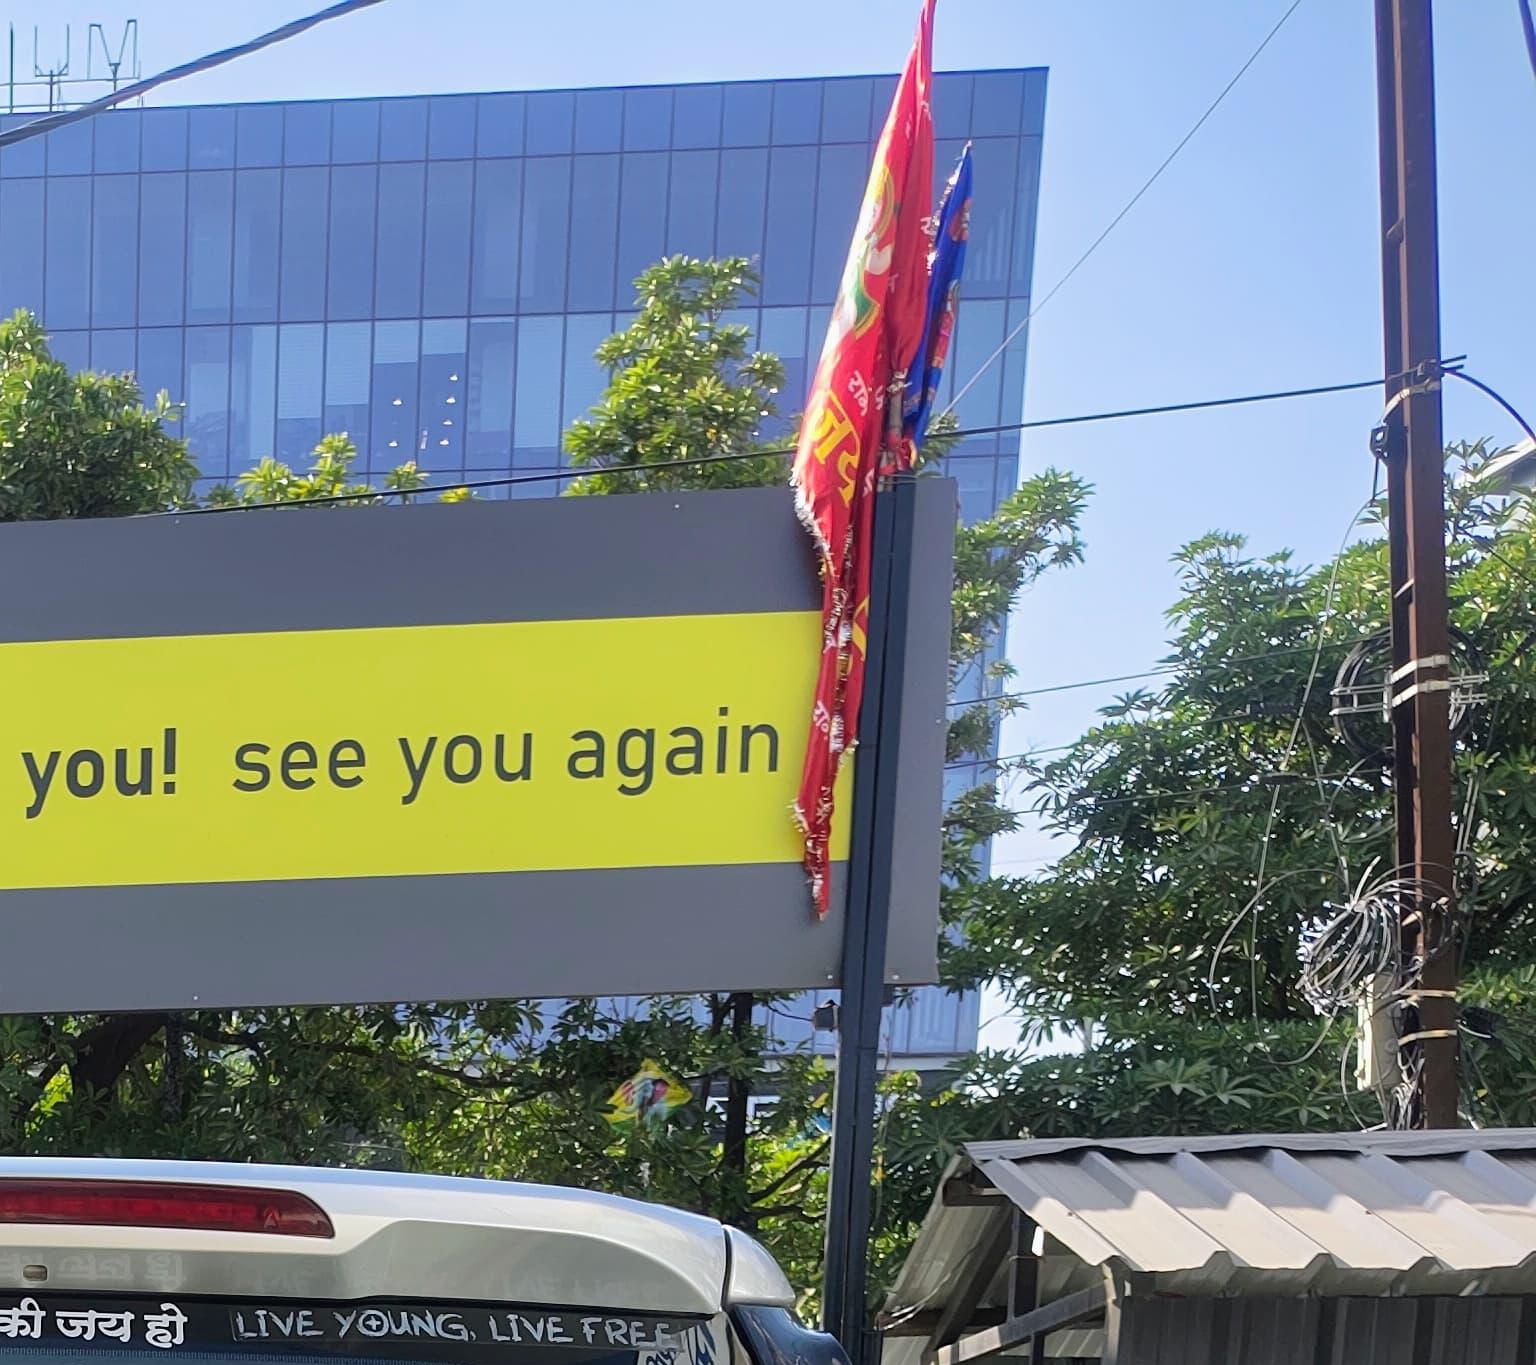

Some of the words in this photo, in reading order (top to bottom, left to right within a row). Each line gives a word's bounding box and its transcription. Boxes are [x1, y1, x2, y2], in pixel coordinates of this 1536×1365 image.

[23, 728, 179, 818] you!
[232, 742, 367, 792] see
[398, 730, 534, 804] you
[566, 706, 780, 796] again
[56, 1308, 135, 1343] जय
[144, 1303, 188, 1348] हो
[235, 1310, 324, 1340] LIVE
[489, 1314, 574, 1344] LIVE
[580, 1317, 676, 1348] FREE
